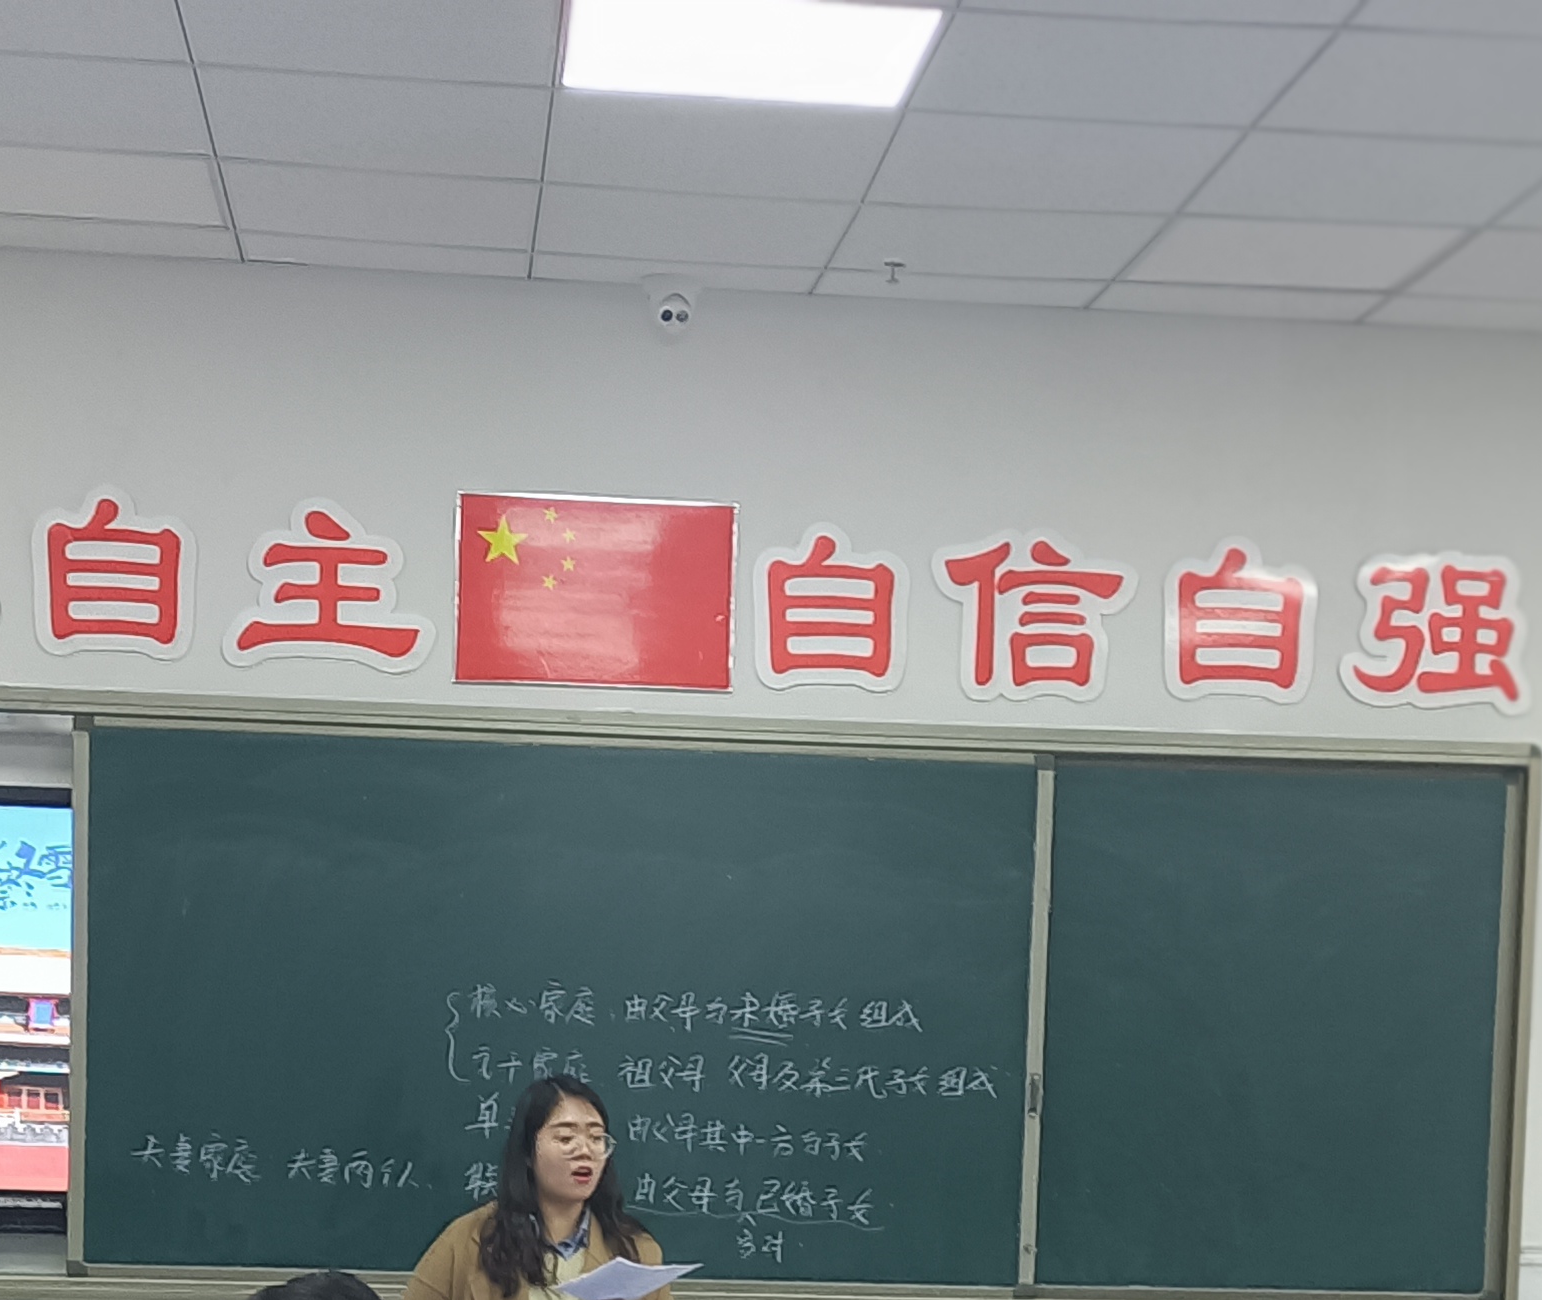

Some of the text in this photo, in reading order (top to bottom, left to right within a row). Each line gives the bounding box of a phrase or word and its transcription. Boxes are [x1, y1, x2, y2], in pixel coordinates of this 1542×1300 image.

[766, 534, 1520, 703] 自信自强
[468, 978, 596, 1027] 核心家庭
[617, 1054, 706, 1094] 祖父母
[130, 1129, 262, 1185] 夫妻家庭
